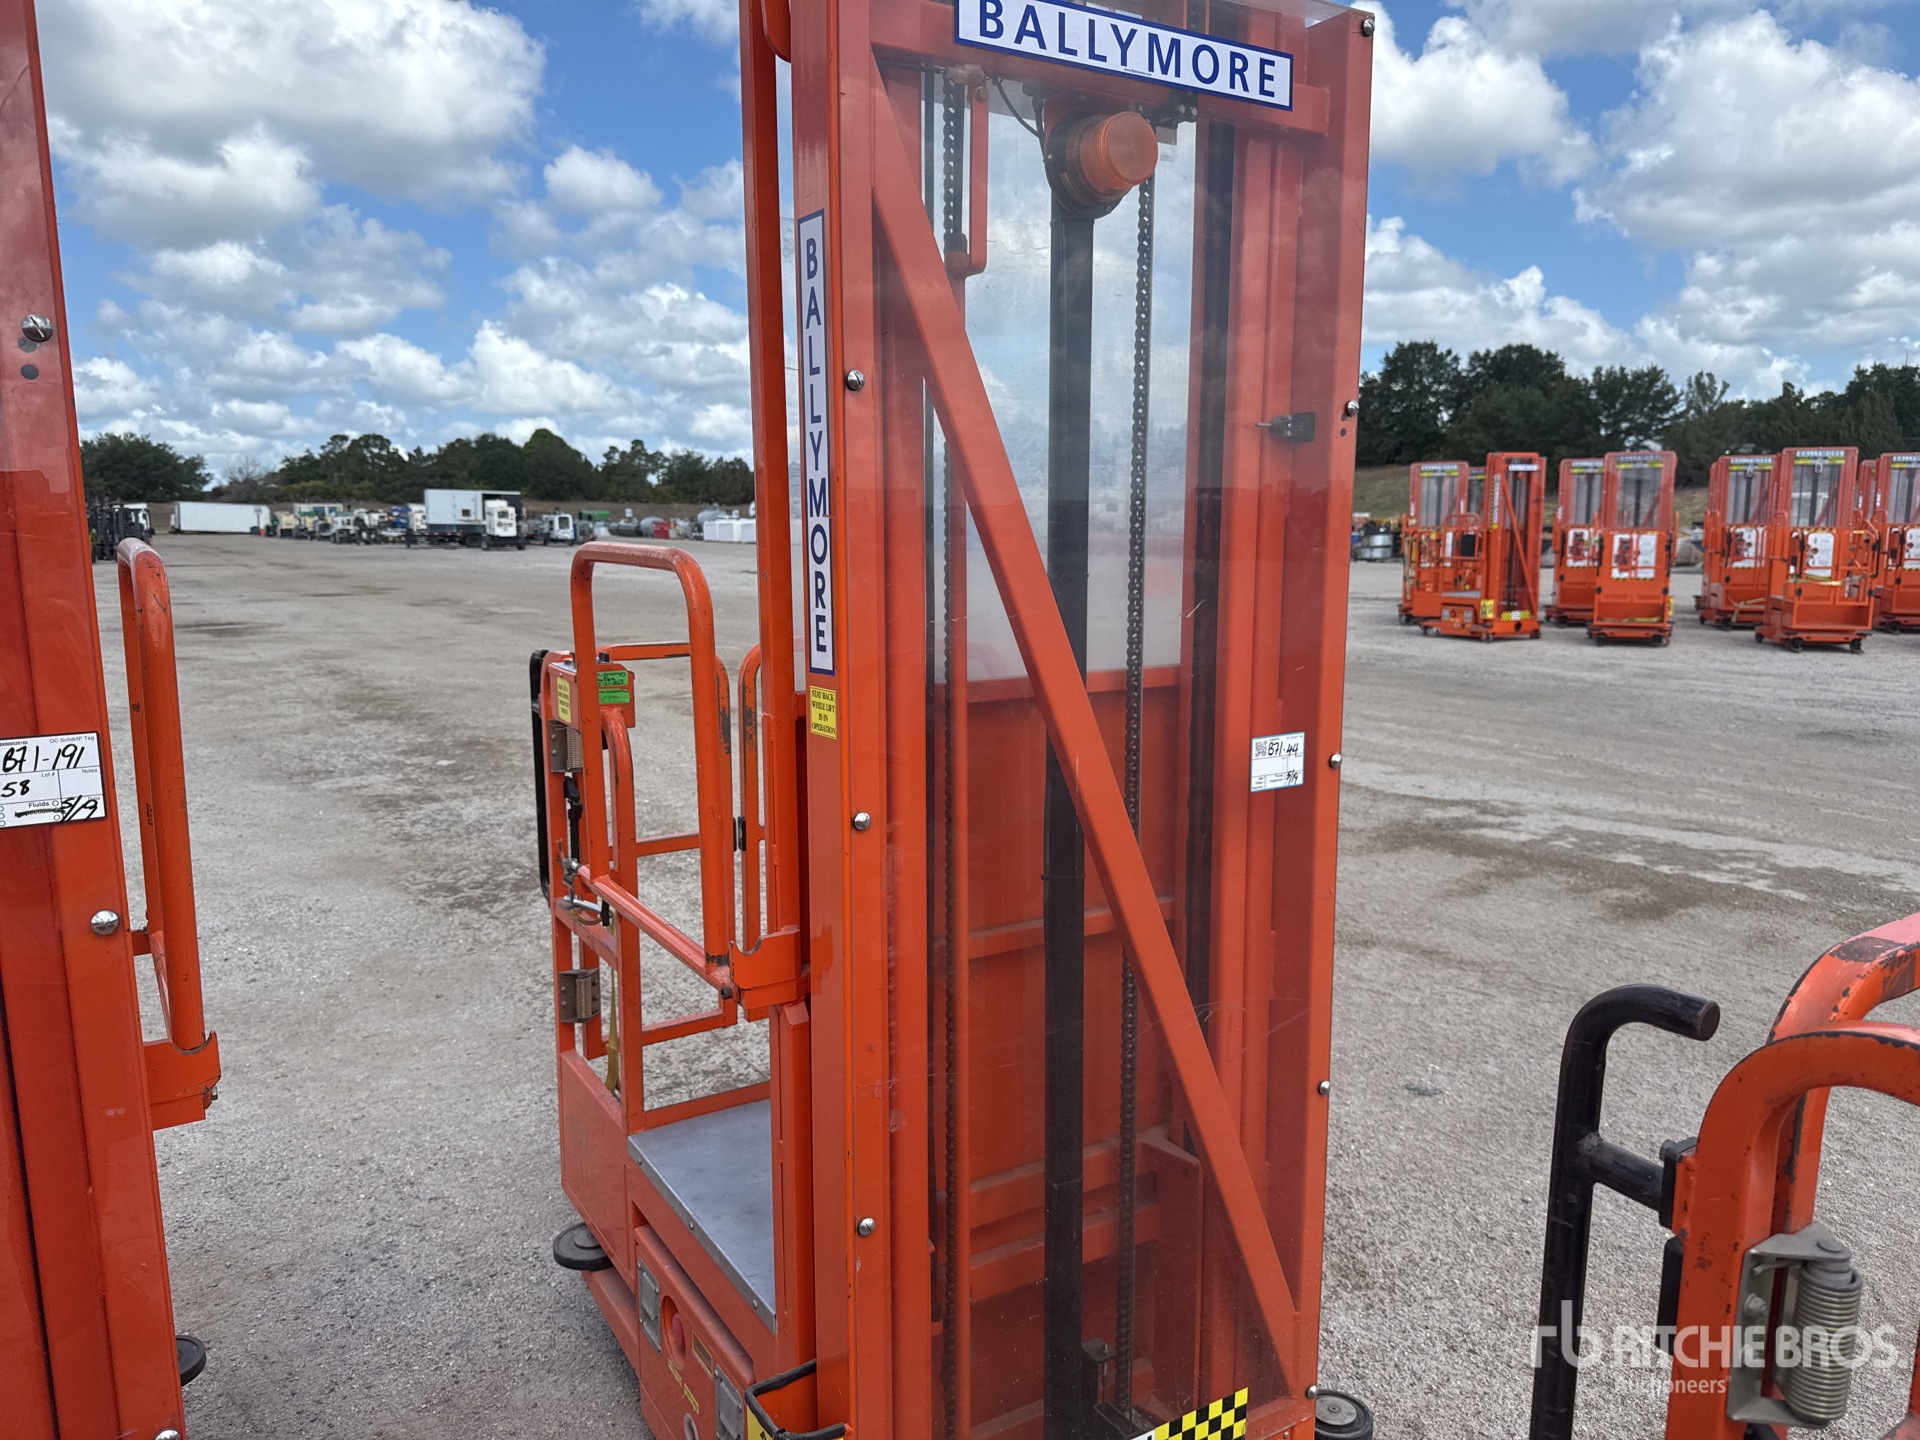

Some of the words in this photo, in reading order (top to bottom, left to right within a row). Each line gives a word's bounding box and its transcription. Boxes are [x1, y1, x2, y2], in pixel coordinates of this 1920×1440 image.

[979, 0, 1276, 98] BALLYMORE
[806, 237, 828, 653] BALLYMORE
[812, 690, 821, 699] STAY
[822, 692, 835, 701] BACK
[812, 701, 825, 711] WHILE
[826, 704, 835, 713] LIFT
[818, 713, 823, 721] IS
[823, 714, 829, 722] IN
[811, 722, 836, 734] OPERATION
[2, 743, 85, 773] B71-191
